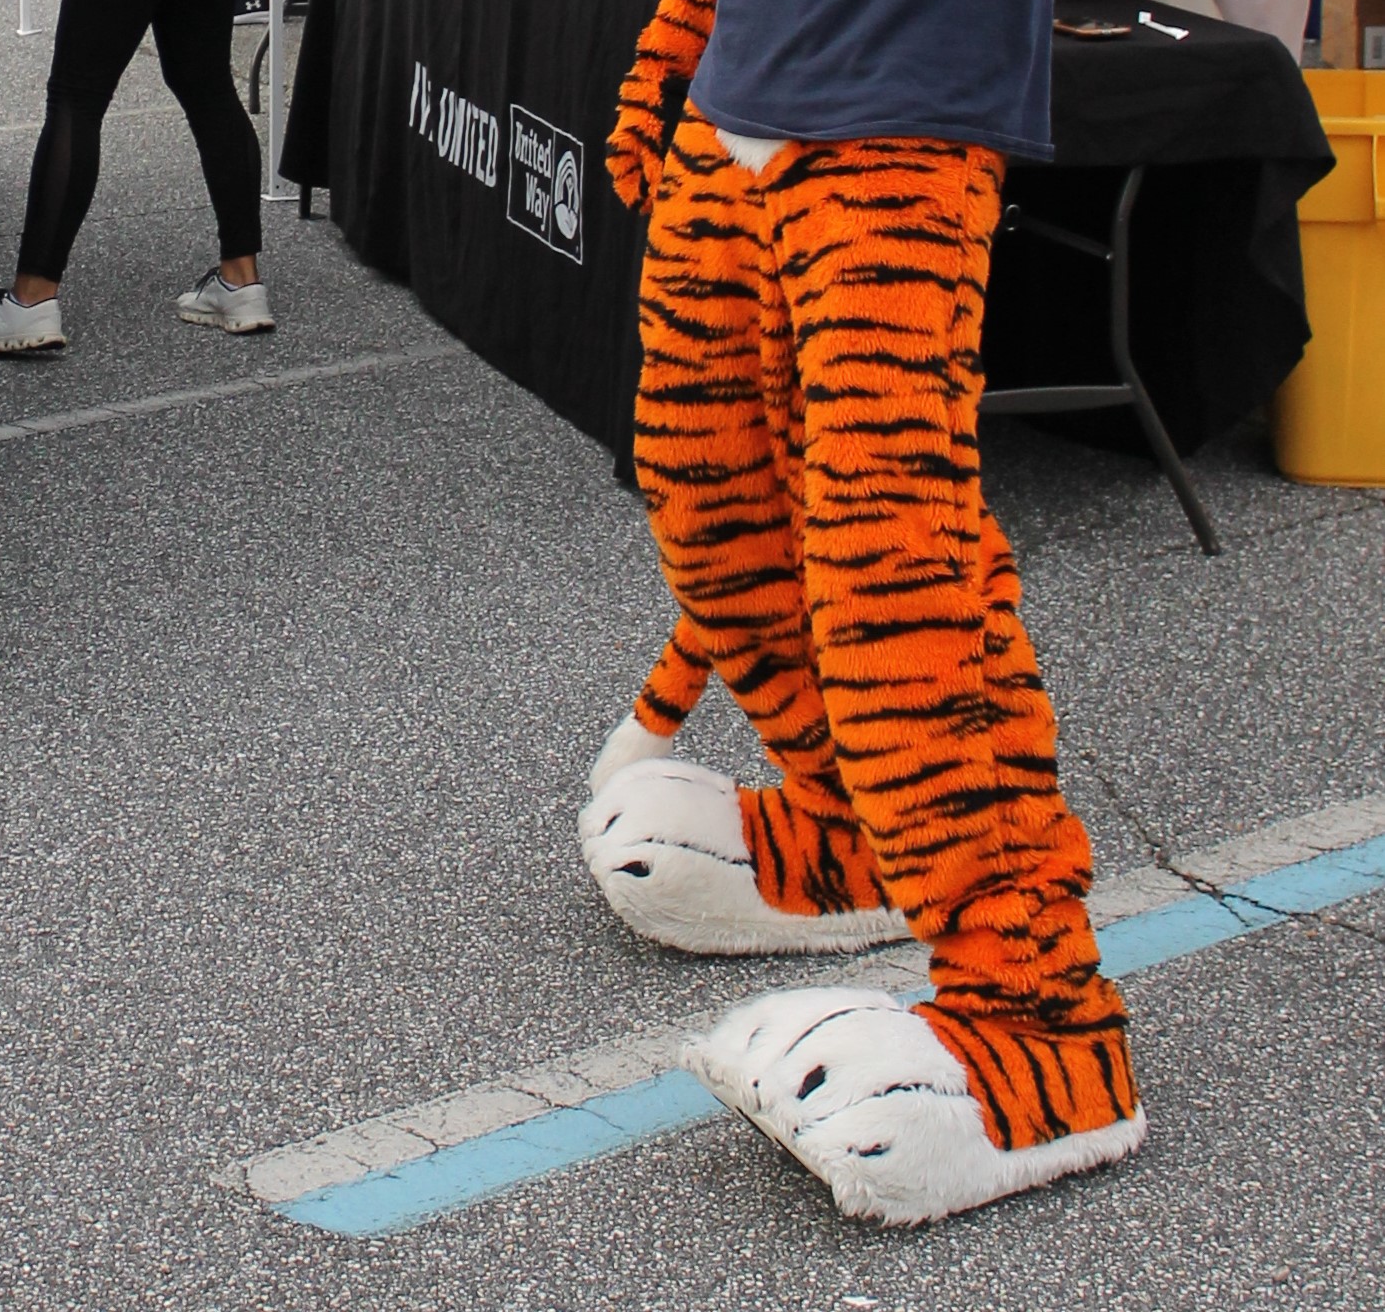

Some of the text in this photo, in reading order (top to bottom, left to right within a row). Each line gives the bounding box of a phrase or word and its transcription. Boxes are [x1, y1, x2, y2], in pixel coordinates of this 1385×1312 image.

[437, 87, 499, 188] UNITED
[514, 120, 552, 179] United
[525, 171, 550, 232] Way
